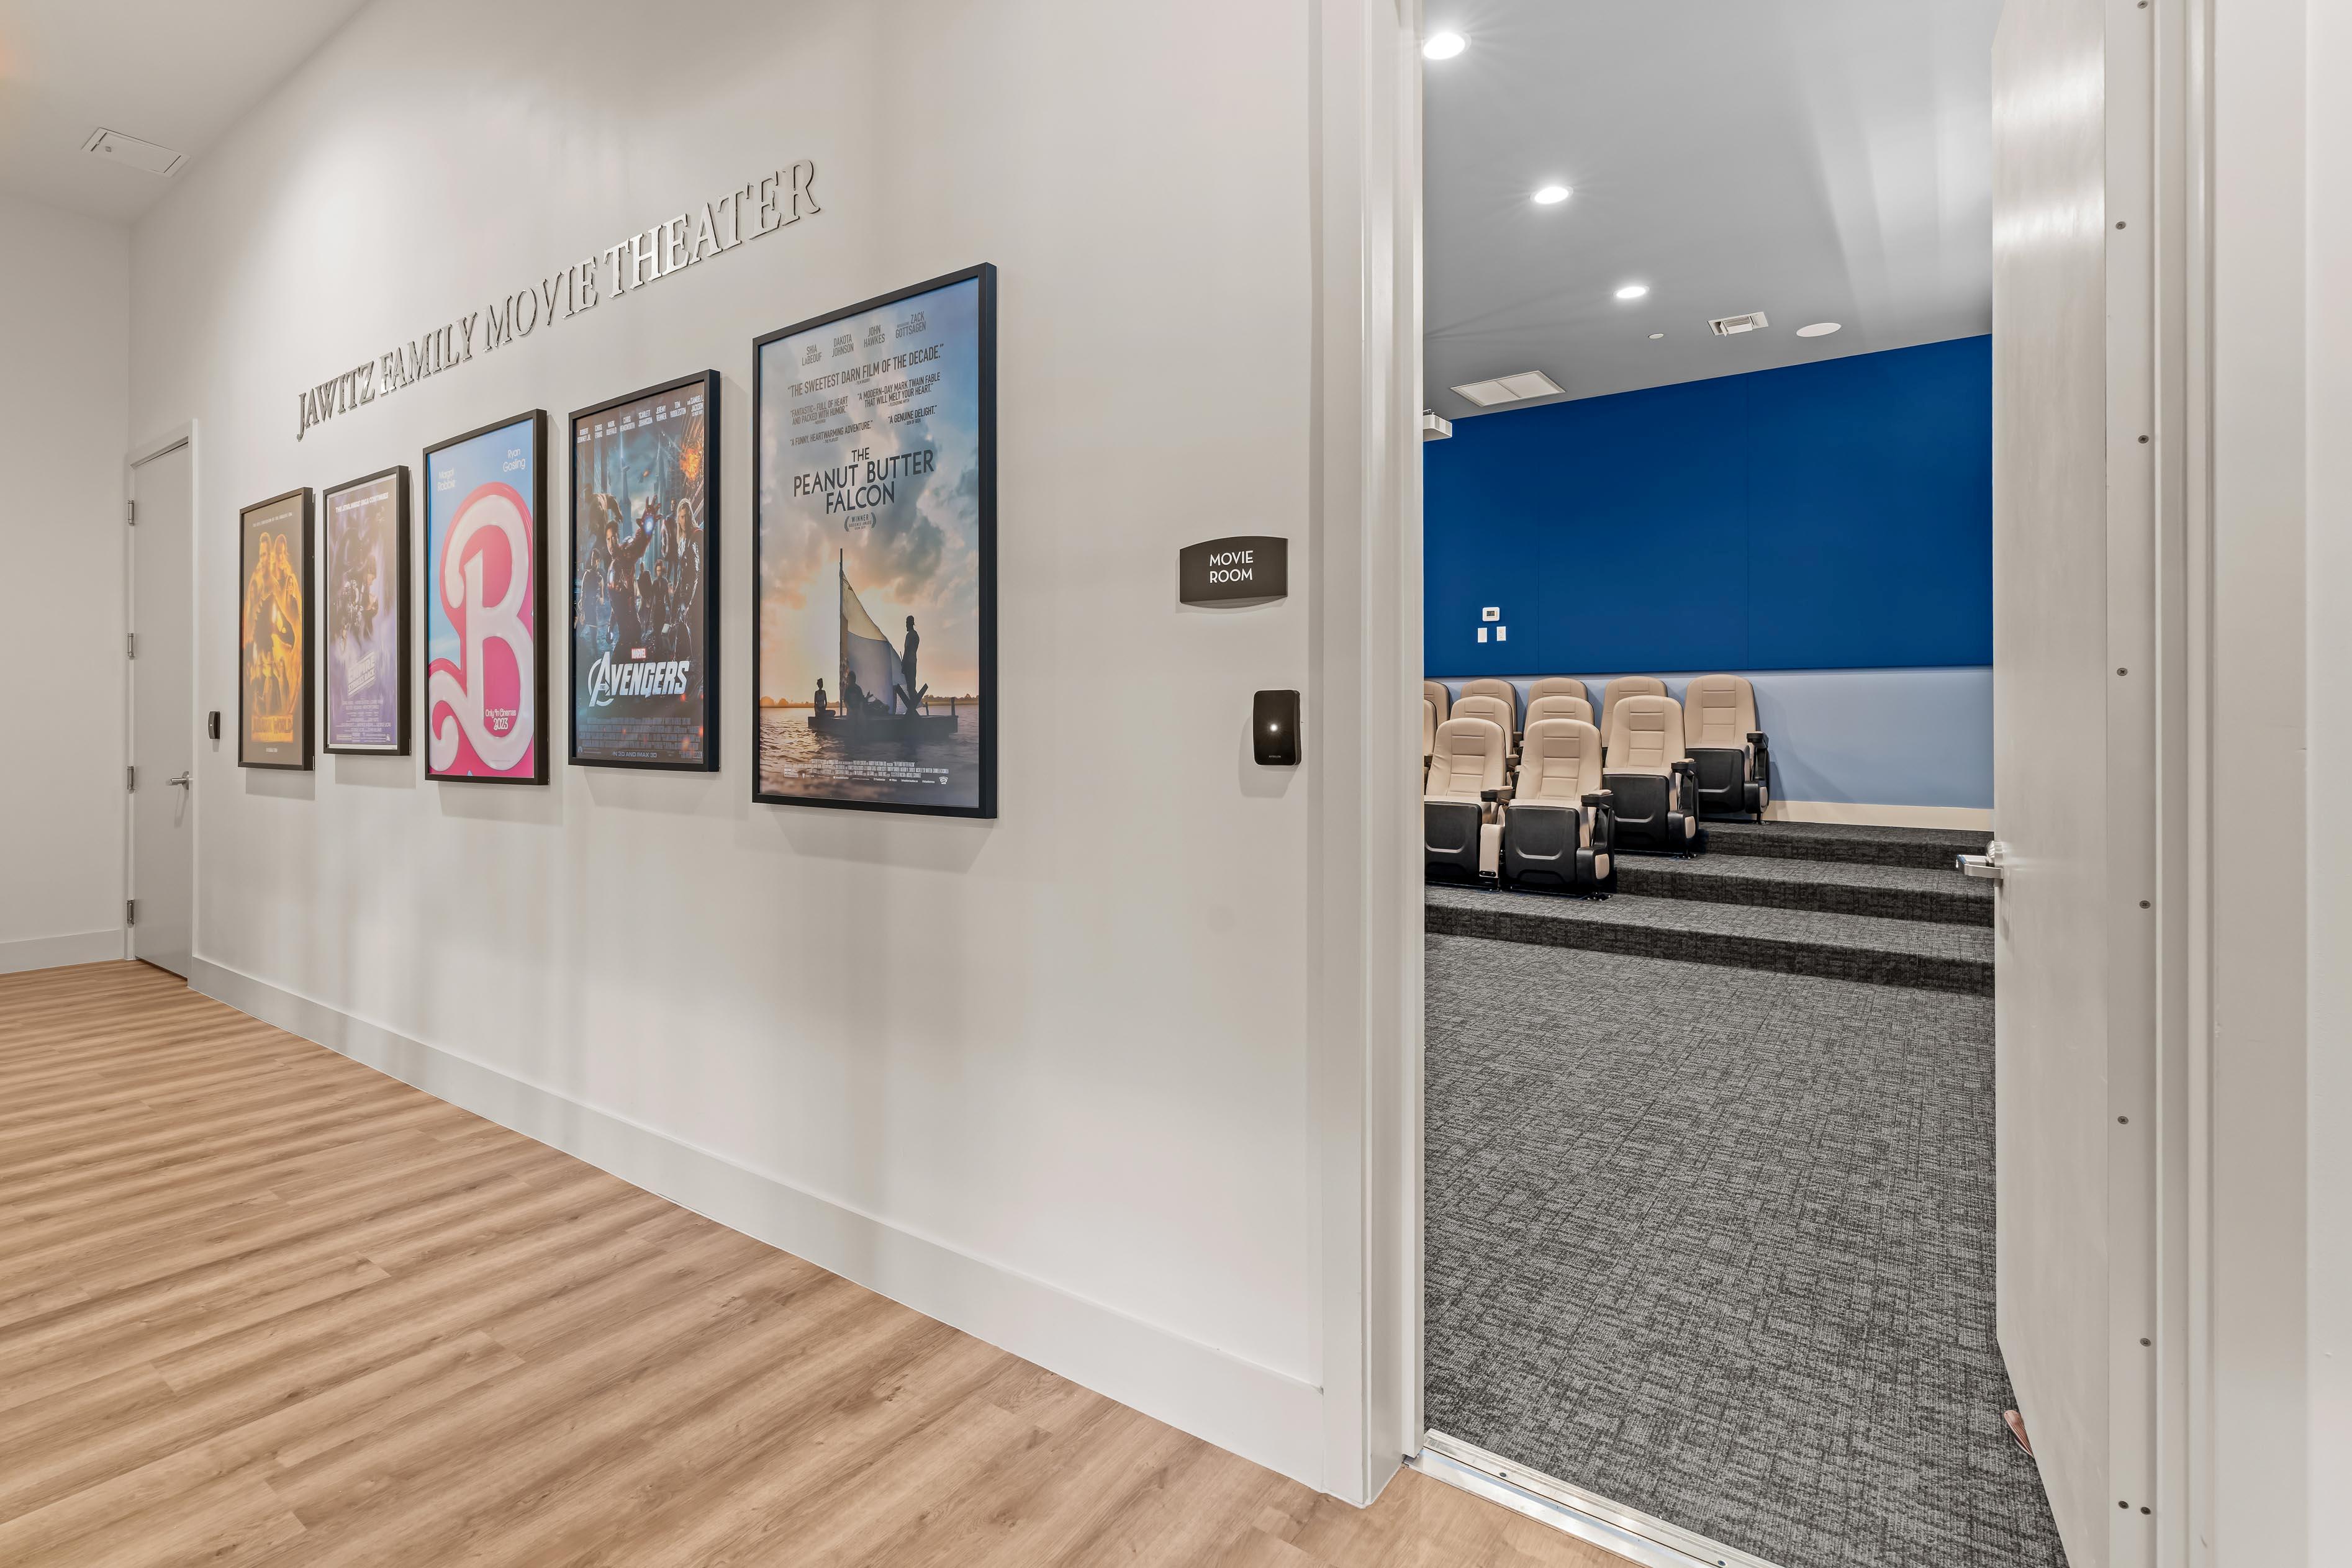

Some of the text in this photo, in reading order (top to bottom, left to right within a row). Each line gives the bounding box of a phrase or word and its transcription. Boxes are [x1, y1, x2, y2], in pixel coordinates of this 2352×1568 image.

[296, 159, 821, 442] JAWITZ FAMILY MOVIE THEATER
[911, 311, 925, 323] ZACK
[868, 325, 880, 337] JOHN
[896, 322, 926, 338] GOTTSAGEN
[833, 334, 853, 348] DAKOTA
[864, 333, 885, 348] HAWKES
[807, 344, 817, 356] SHIA
[832, 343, 854, 358] JOHNSON
[805, 373, 839, 394] SWEETEST
[842, 367, 861, 384] DARN
[862, 362, 879, 379] FILM
[882, 358, 891, 372] OF
[893, 354, 907, 370] THE
[864, 385, 893, 400] MODERN-DAY
[894, 382, 908, 393] MARK
[909, 378, 924, 390] TWAIN
[925, 372, 941, 385] FABLE
[816, 402, 826, 411] FULL
[828, 399, 834, 408] OF
[835, 396, 848, 407] HEART
[865, 398, 875, 408] THAT
[877, 395, 887, 405] WILL
[889, 392, 900, 402] MELT
[902, 388, 914, 399] YOUR
[792, 416, 800, 426] AND
[802, 413, 817, 424] PACKED
[818, 410, 829, 420] WITH
[894, 410, 913, 423] GENUINE
[810, 428, 844, 443] HEARTWARMING
[507, 448, 520, 459] Ryan
[851, 447, 869, 462] THE
[503, 457, 526, 473] Gosling
[794, 449, 934, 497] PEANUT BUTTER
[437, 479, 456, 492] Robbie
[826, 481, 895, 515] FALCON
[852, 514, 869, 523] WINNER
[1210, 550, 1254, 567] MOVIE
[1210, 567, 1253, 583] ROOM
[631, 649, 646, 659] MARVEL
[589, 652, 690, 707] AVENGERS
[486, 709, 494, 719] Only
[499, 708, 517, 716] Cinemas
[493, 718, 509, 731] 2023
